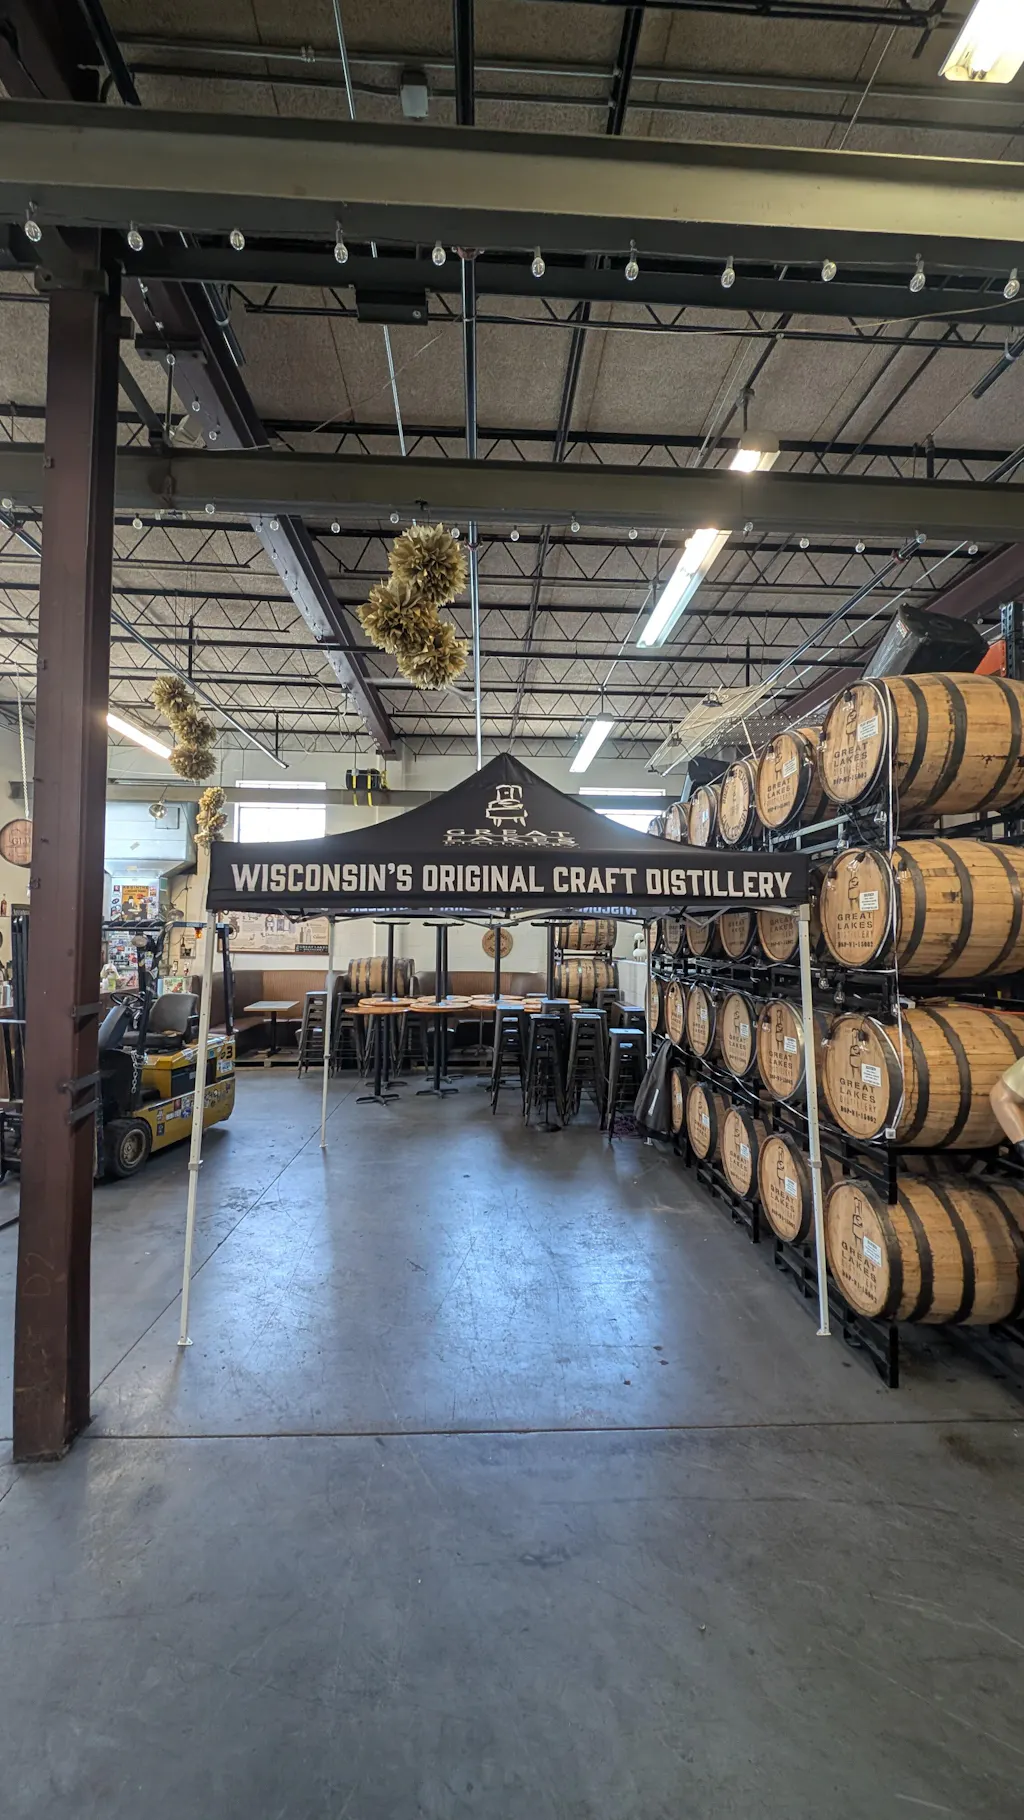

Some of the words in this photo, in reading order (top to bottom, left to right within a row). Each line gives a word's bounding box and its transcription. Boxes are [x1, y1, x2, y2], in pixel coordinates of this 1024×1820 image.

[834, 742, 868, 759] GREAT
[834, 752, 868, 768] LAKES
[767, 778, 791, 792] GREAT
[767, 785, 791, 799] LAKES
[230, 863, 413, 892] WISCONSIN'S
[422, 865, 545, 892] ORIGINAL
[553, 867, 637, 894] CRAFT
[645, 869, 792, 898] DISTILLERY
[837, 911, 873, 921] GREAT
[837, 921, 873, 930] LAKES
[769, 1051, 793, 1061] GREAT
[769, 1058, 793, 1069] LAKES
[840, 1077, 875, 1094] GREAT
[840, 1086, 876, 1104] LAKES
[841, 1241, 876, 1272] GREAT
[841, 1250, 877, 1284] LAKES
